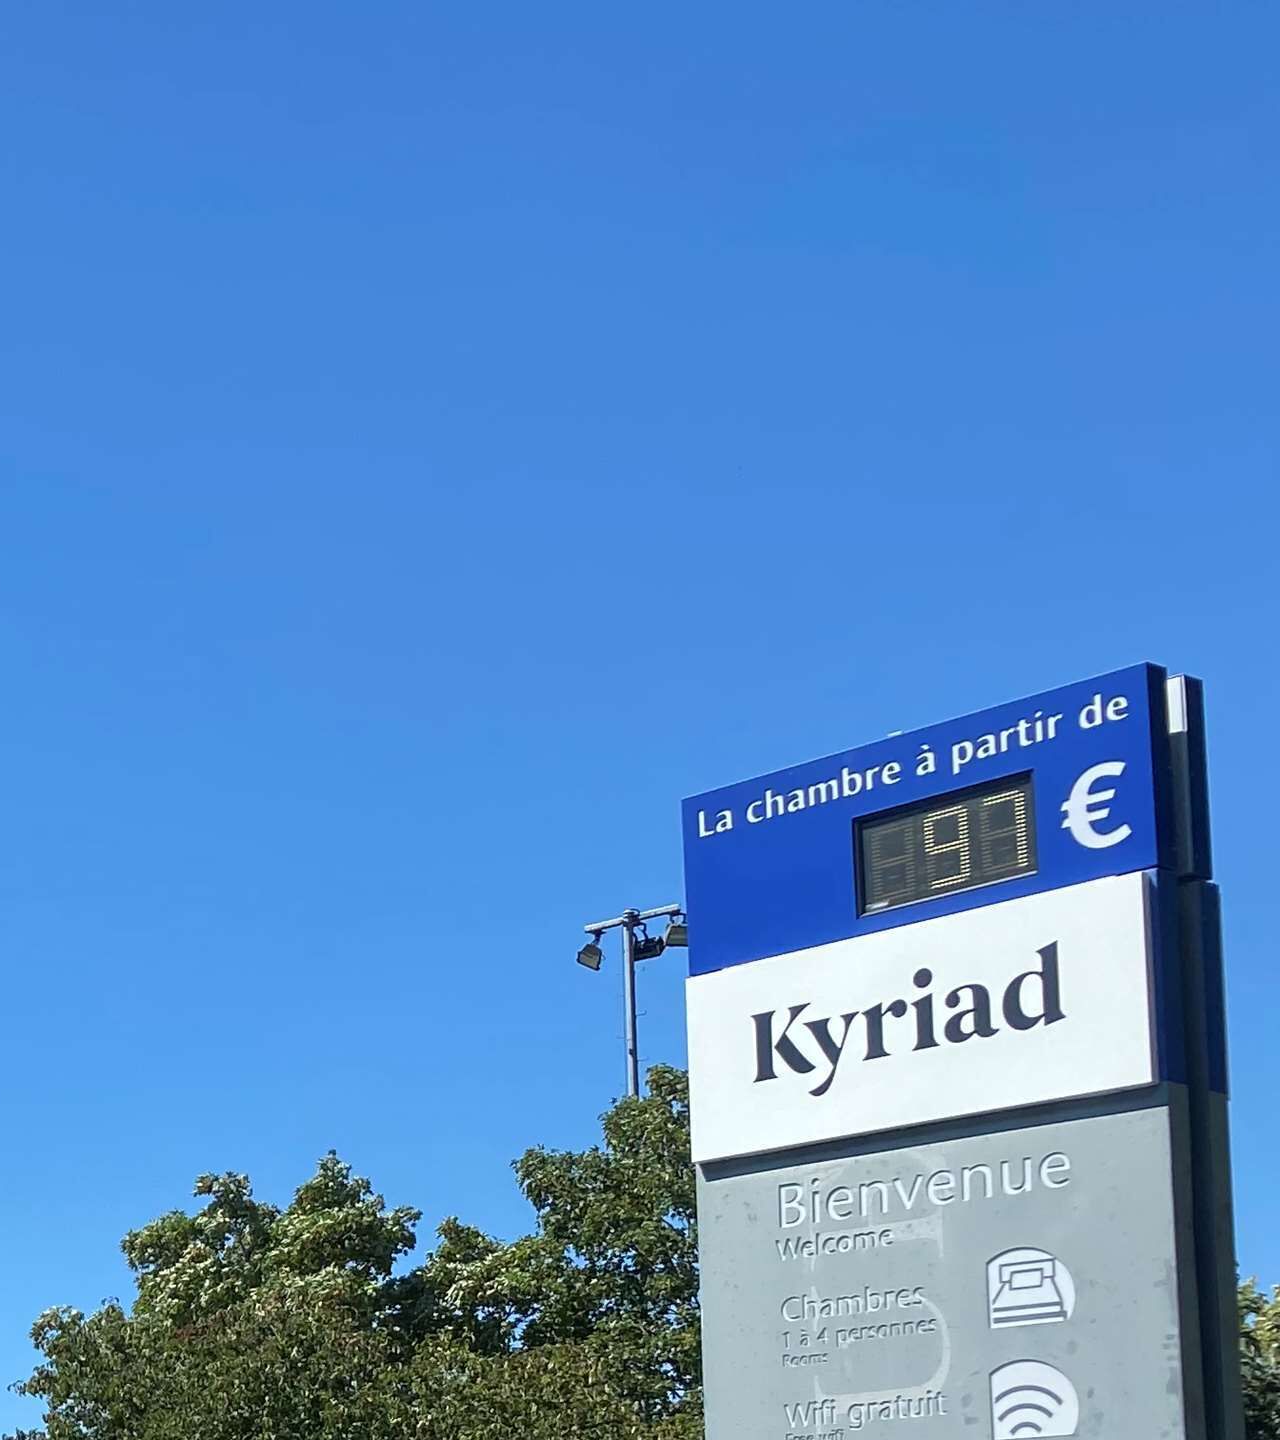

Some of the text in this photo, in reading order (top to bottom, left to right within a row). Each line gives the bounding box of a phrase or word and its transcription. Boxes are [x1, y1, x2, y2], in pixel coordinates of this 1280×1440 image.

[697, 692, 1129, 838] La chambre à partir de
[1060, 760, 1133, 850] €
[922, 789, 1029, 889] 97
[750, 940, 1067, 1097] Kyriad
[776, 1150, 1072, 1229] Bienvenue
[775, 1227, 895, 1261] Welcome
[780, 1284, 925, 1322] Chambres
[816, 1327, 828, 1345] 4
[835, 1317, 938, 1348] personnes
[782, 1352, 829, 1368] Rooms
[783, 1389, 948, 1431] Wifi gratuit
